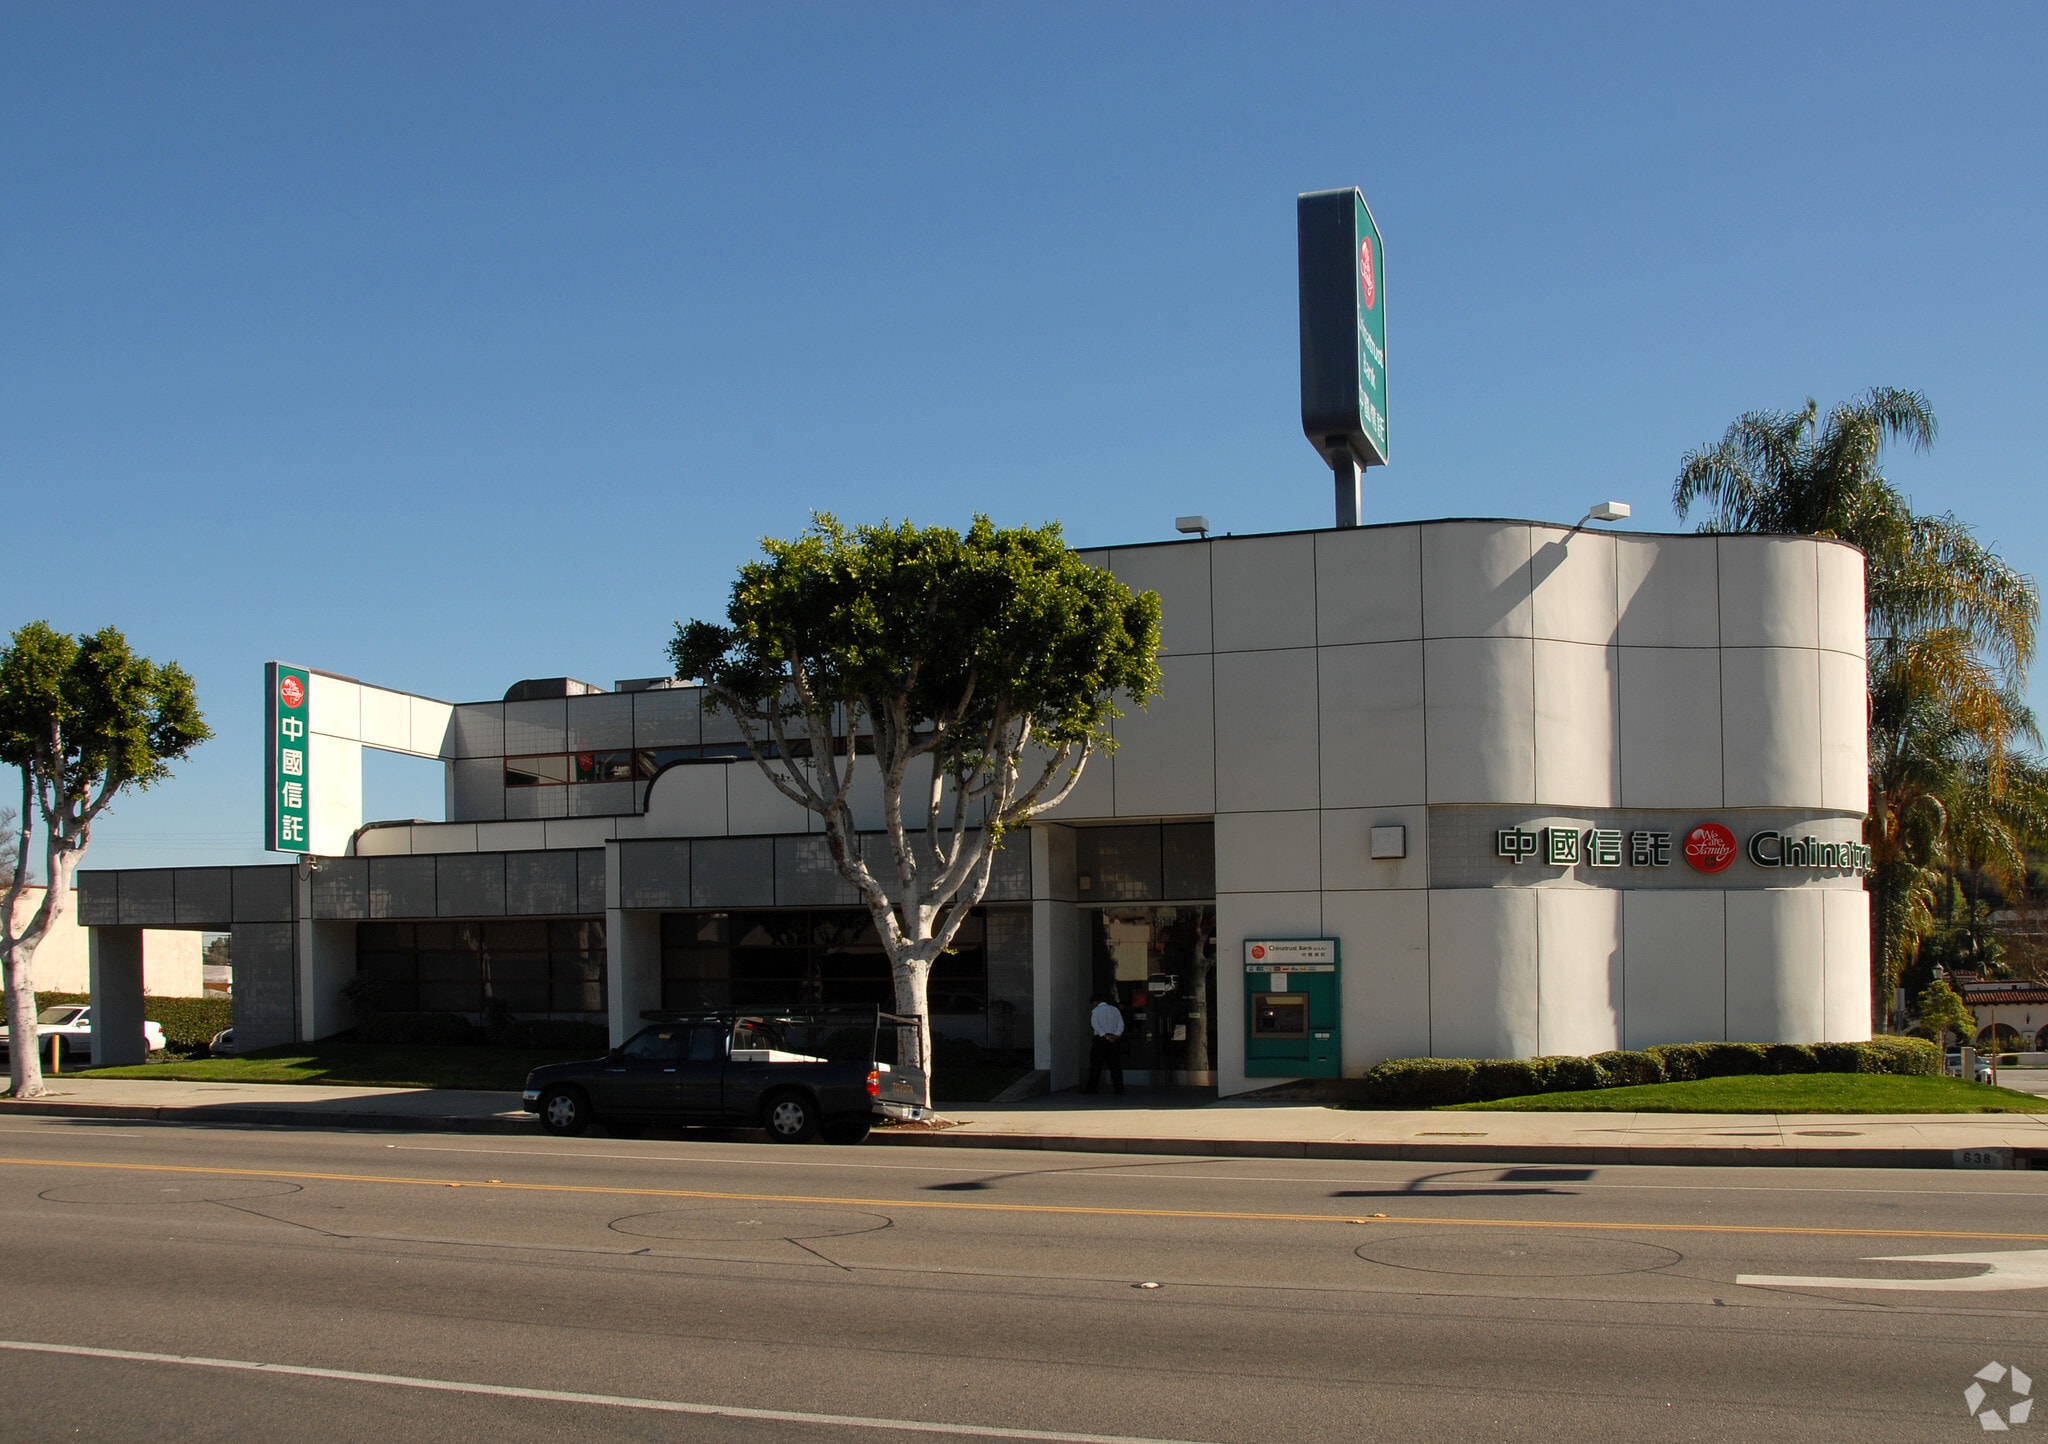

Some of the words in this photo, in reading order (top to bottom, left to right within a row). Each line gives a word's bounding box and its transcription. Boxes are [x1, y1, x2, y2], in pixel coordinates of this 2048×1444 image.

[282, 716, 303, 842] 中國信託
[1691, 828, 1719, 840] We
[1707, 838, 1724, 847] are
[1497, 825, 1673, 867] 中國信託
[1685, 838, 1736, 862] Family
[1963, 1152, 1991, 1164] 638
